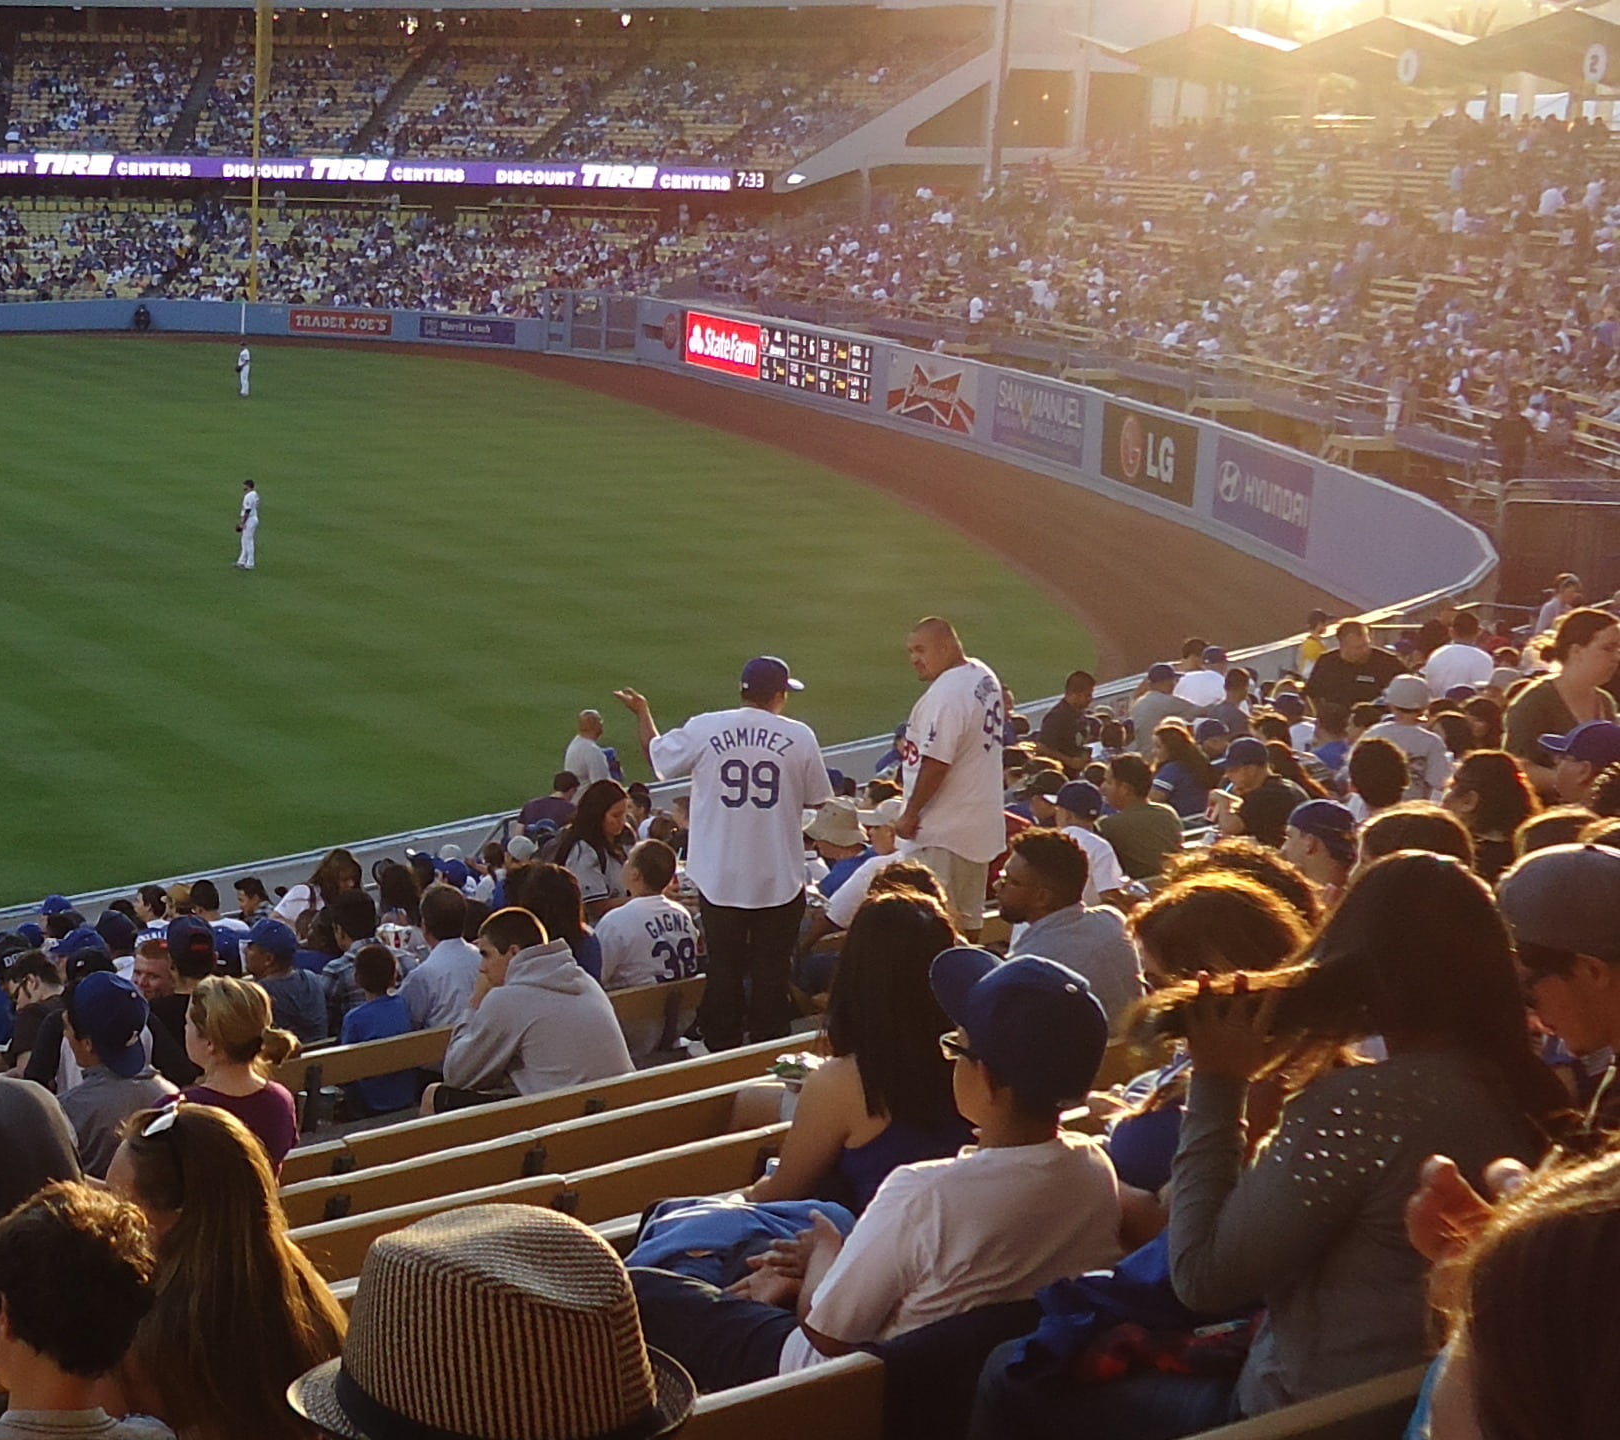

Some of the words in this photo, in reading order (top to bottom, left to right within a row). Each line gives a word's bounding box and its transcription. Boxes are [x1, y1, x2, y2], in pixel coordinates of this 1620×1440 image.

[1589, 55, 1599, 73] 2
[33, 154, 115, 176] TIRE
[116, 162, 191, 178] CENTERS
[222, 163, 305, 179] DISCOUNT
[309, 158, 390, 182] TIRE
[391, 167, 465, 183] CENTERS
[495, 169, 576, 186] DISCOUNT
[580, 164, 659, 188] TIRE
[660, 174, 730, 191] CENTERS
[736, 171, 765, 188] 7:33
[295, 315, 345, 330] TRADER
[348, 316, 387, 332] JOE'S
[998, 379, 1024, 410] SAN
[1031, 389, 1083, 428] MANUEL
[1145, 432, 1175, 484] LG
[1243, 473, 1309, 528] HYUNDAI
[709, 727, 794, 757] RAMIREZ
[721, 759, 780, 809] 99
[644, 913, 690, 939] GAGNE
[651, 937, 696, 984] 38
